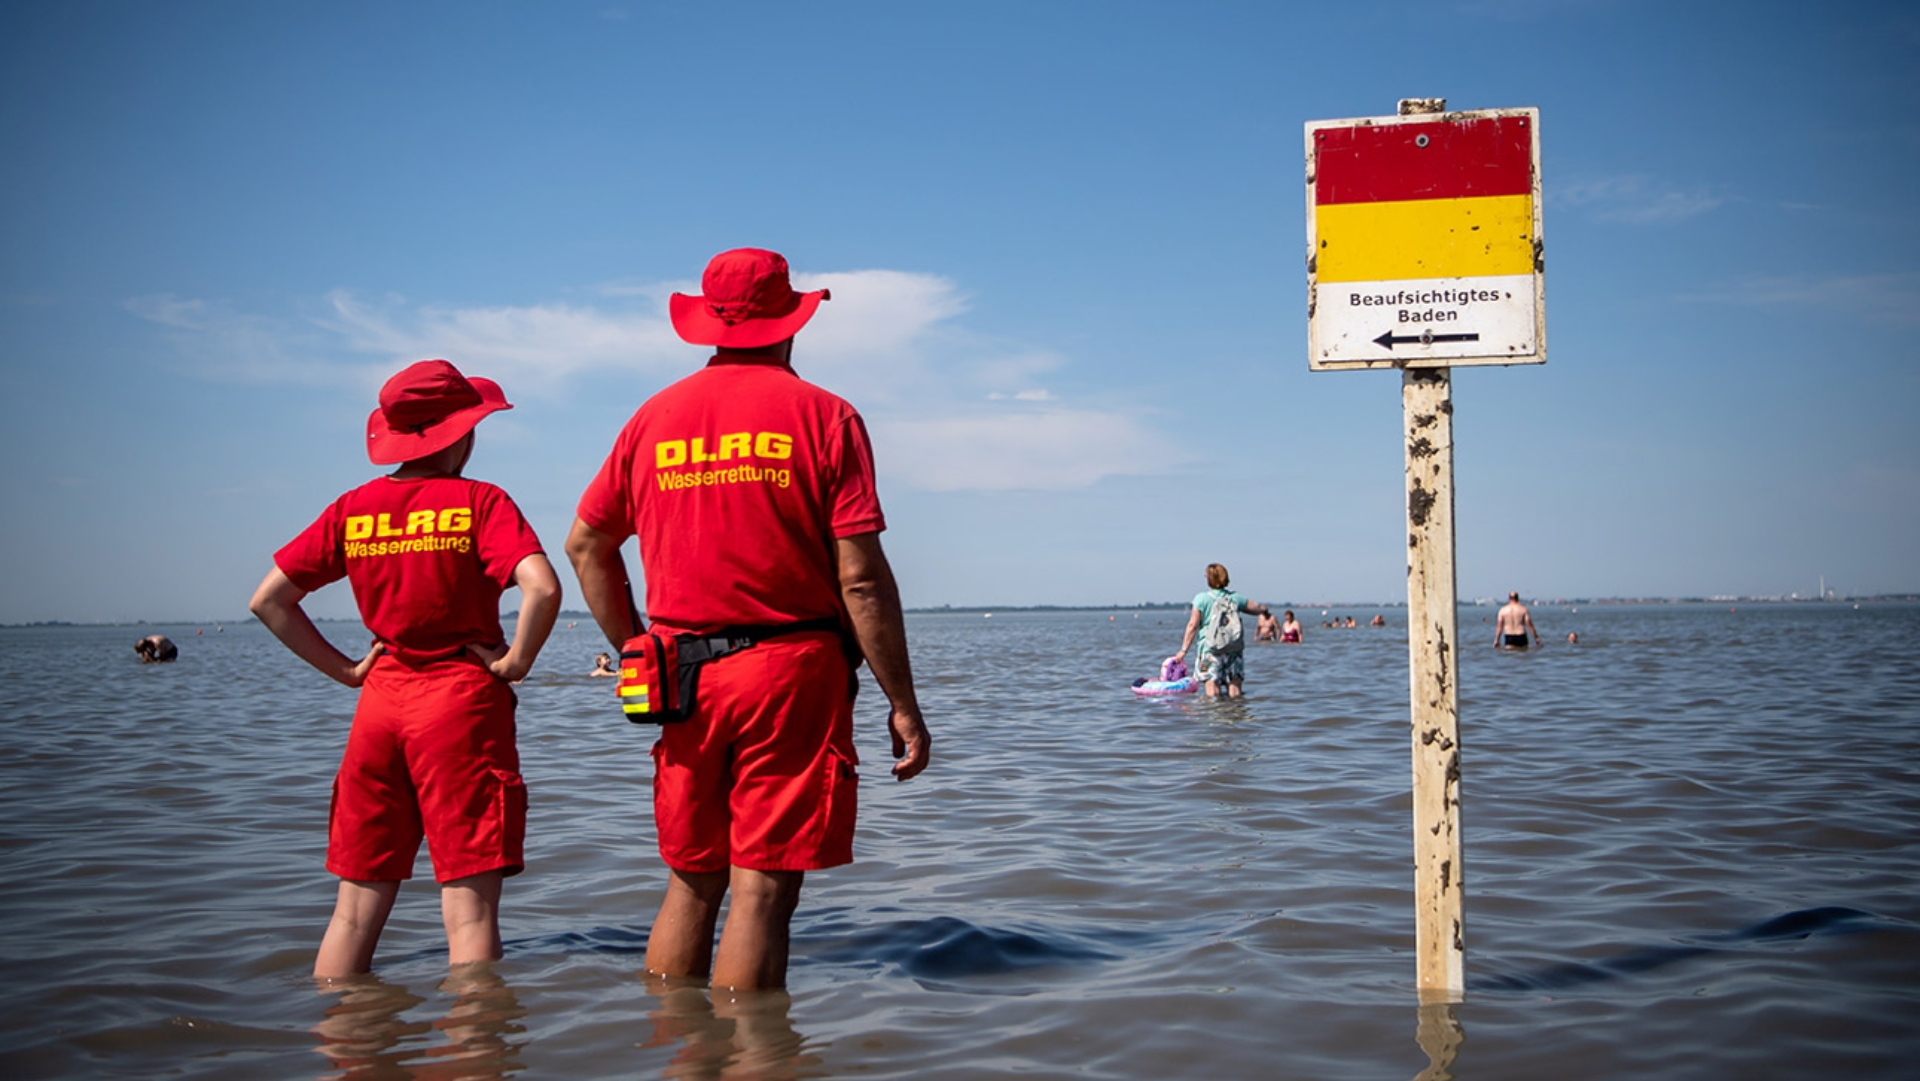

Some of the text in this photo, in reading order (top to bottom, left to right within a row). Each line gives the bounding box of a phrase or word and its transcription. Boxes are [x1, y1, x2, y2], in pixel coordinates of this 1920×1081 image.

[1349, 289, 1500, 306] Beaufsichtigtes
[1398, 309, 1458, 323] Baden
[655, 431, 793, 469] DLRG
[656, 464, 790, 492] Wasserrettung
[345, 507, 472, 540] DLRG
[344, 535, 471, 557] Wasserrettung
